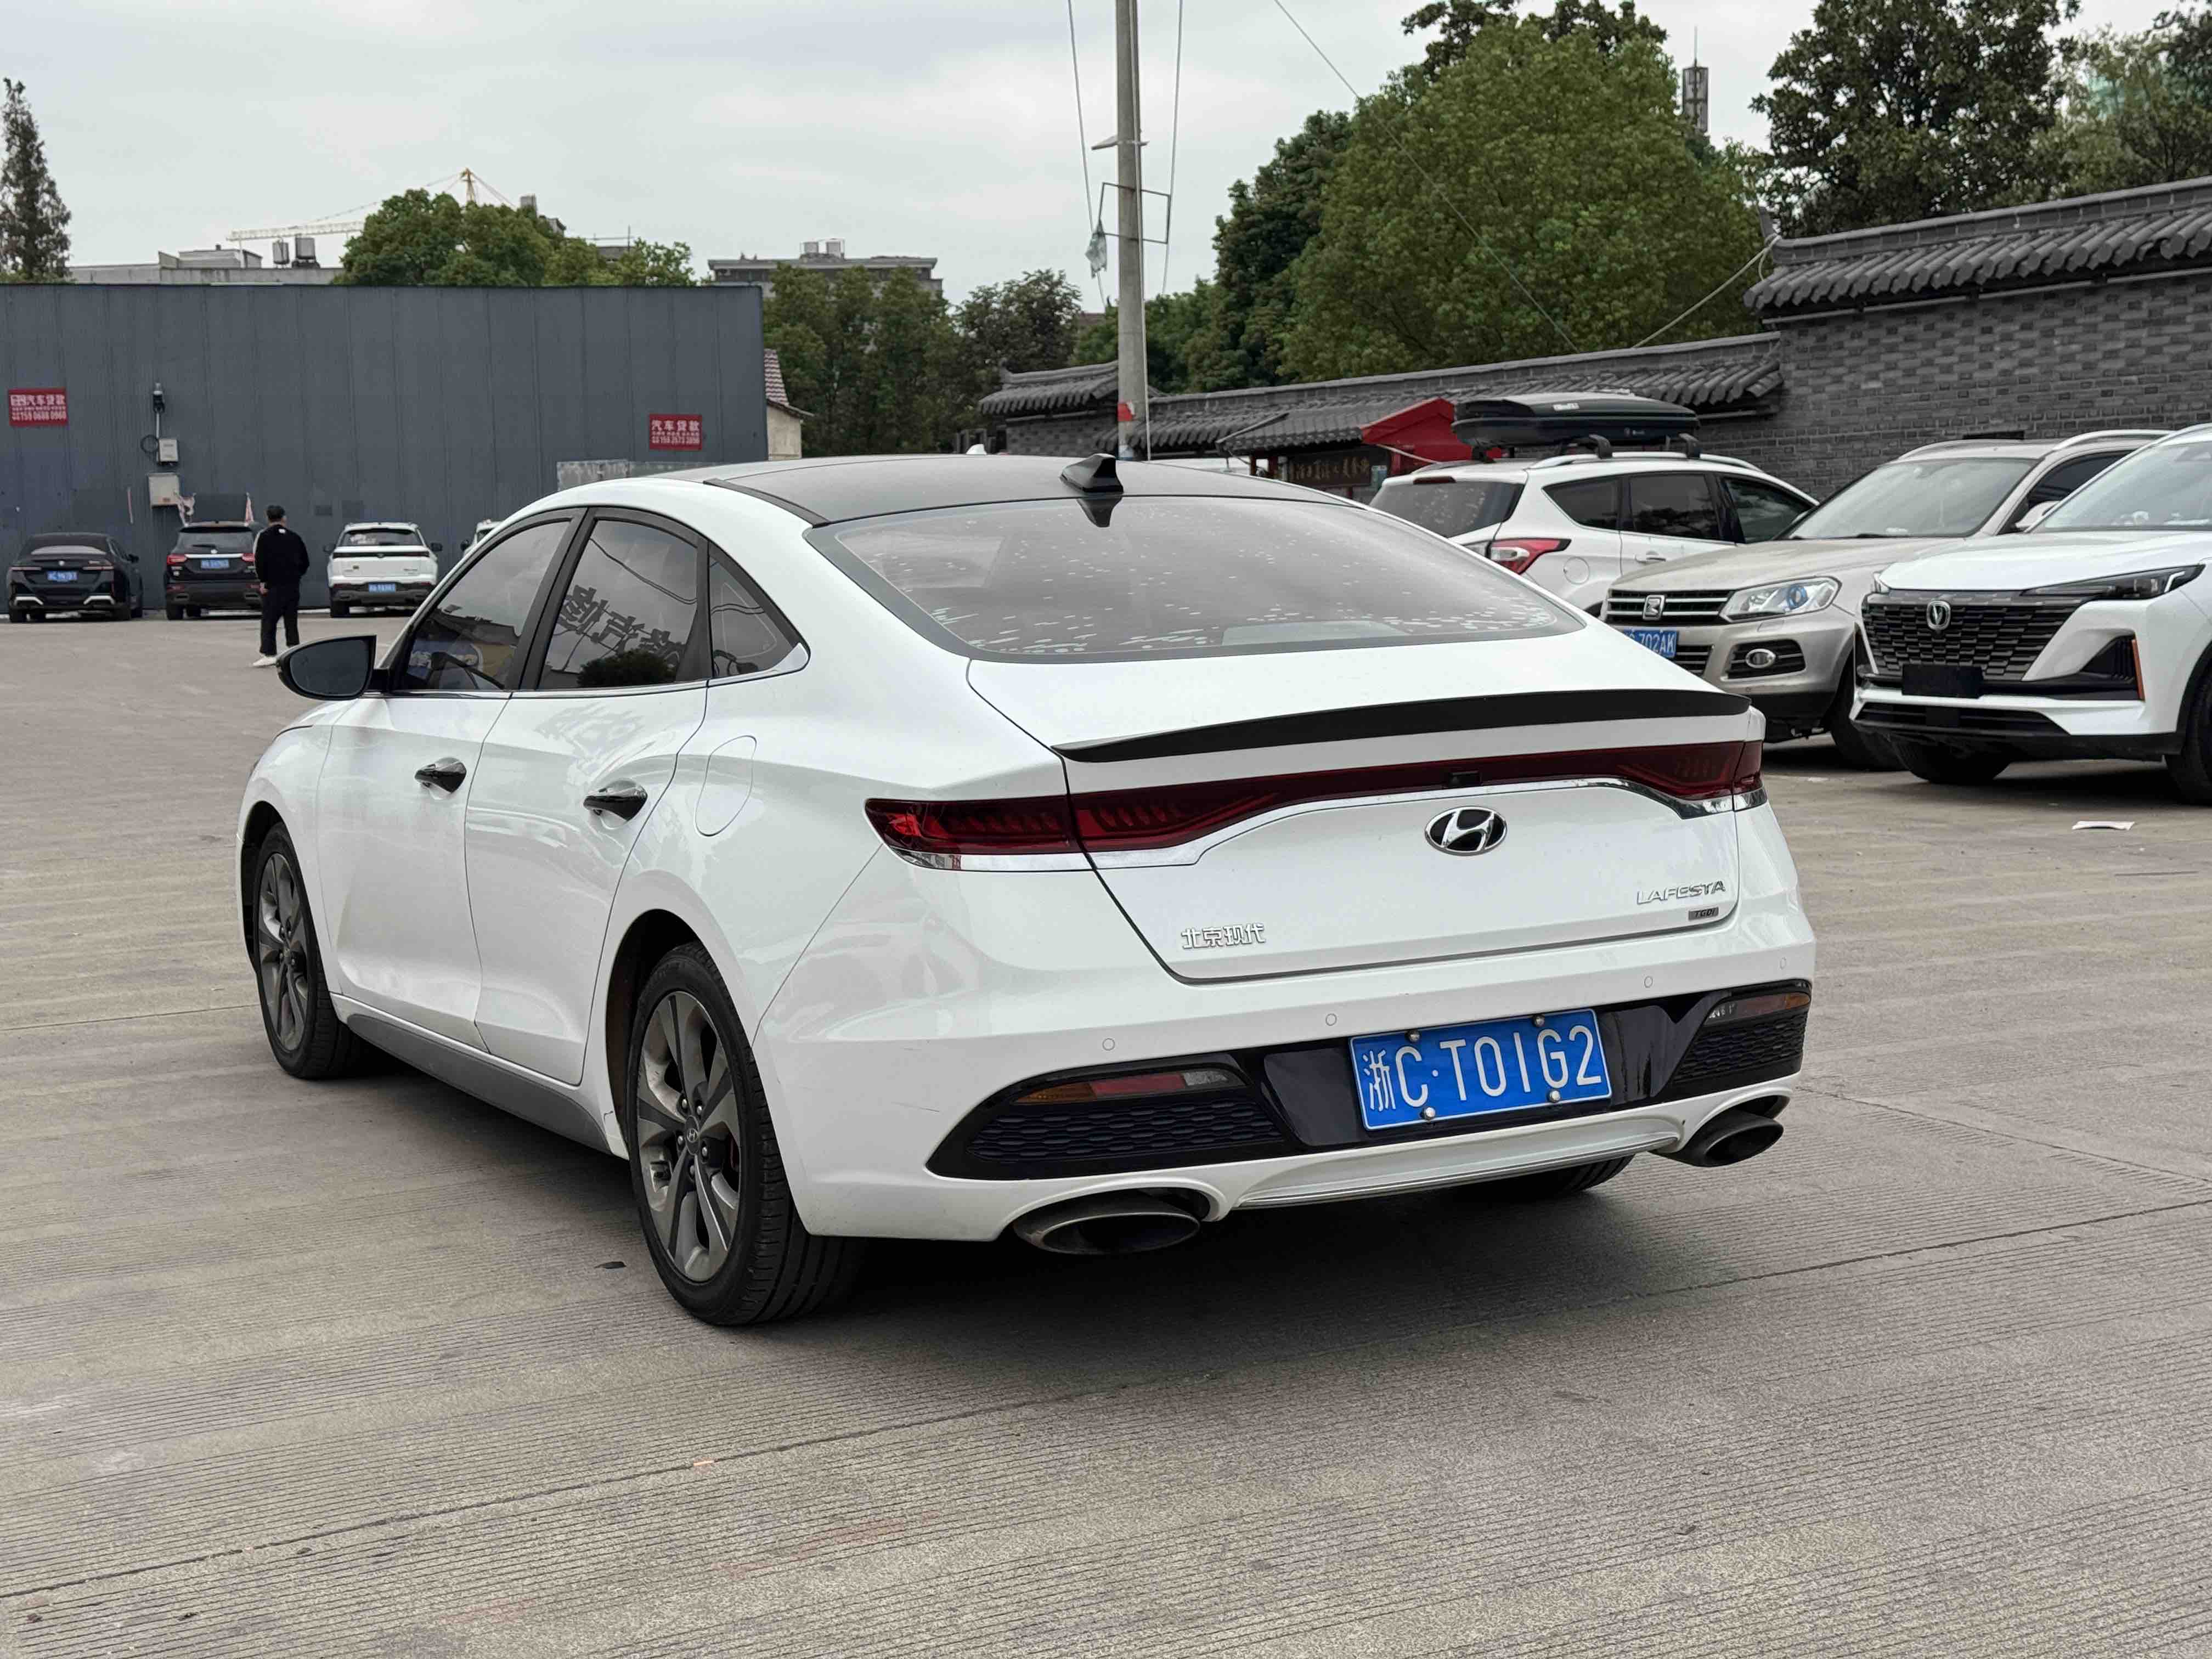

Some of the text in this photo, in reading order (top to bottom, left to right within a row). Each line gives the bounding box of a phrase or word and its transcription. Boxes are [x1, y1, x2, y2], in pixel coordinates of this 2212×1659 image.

[651, 420, 699, 431] 汽车贷款
[1637, 880, 1725, 905] LAFESTA
[1181, 922, 1266, 949] 北京现代
[1362, 1025, 1602, 1112] 浙C·T01G2
